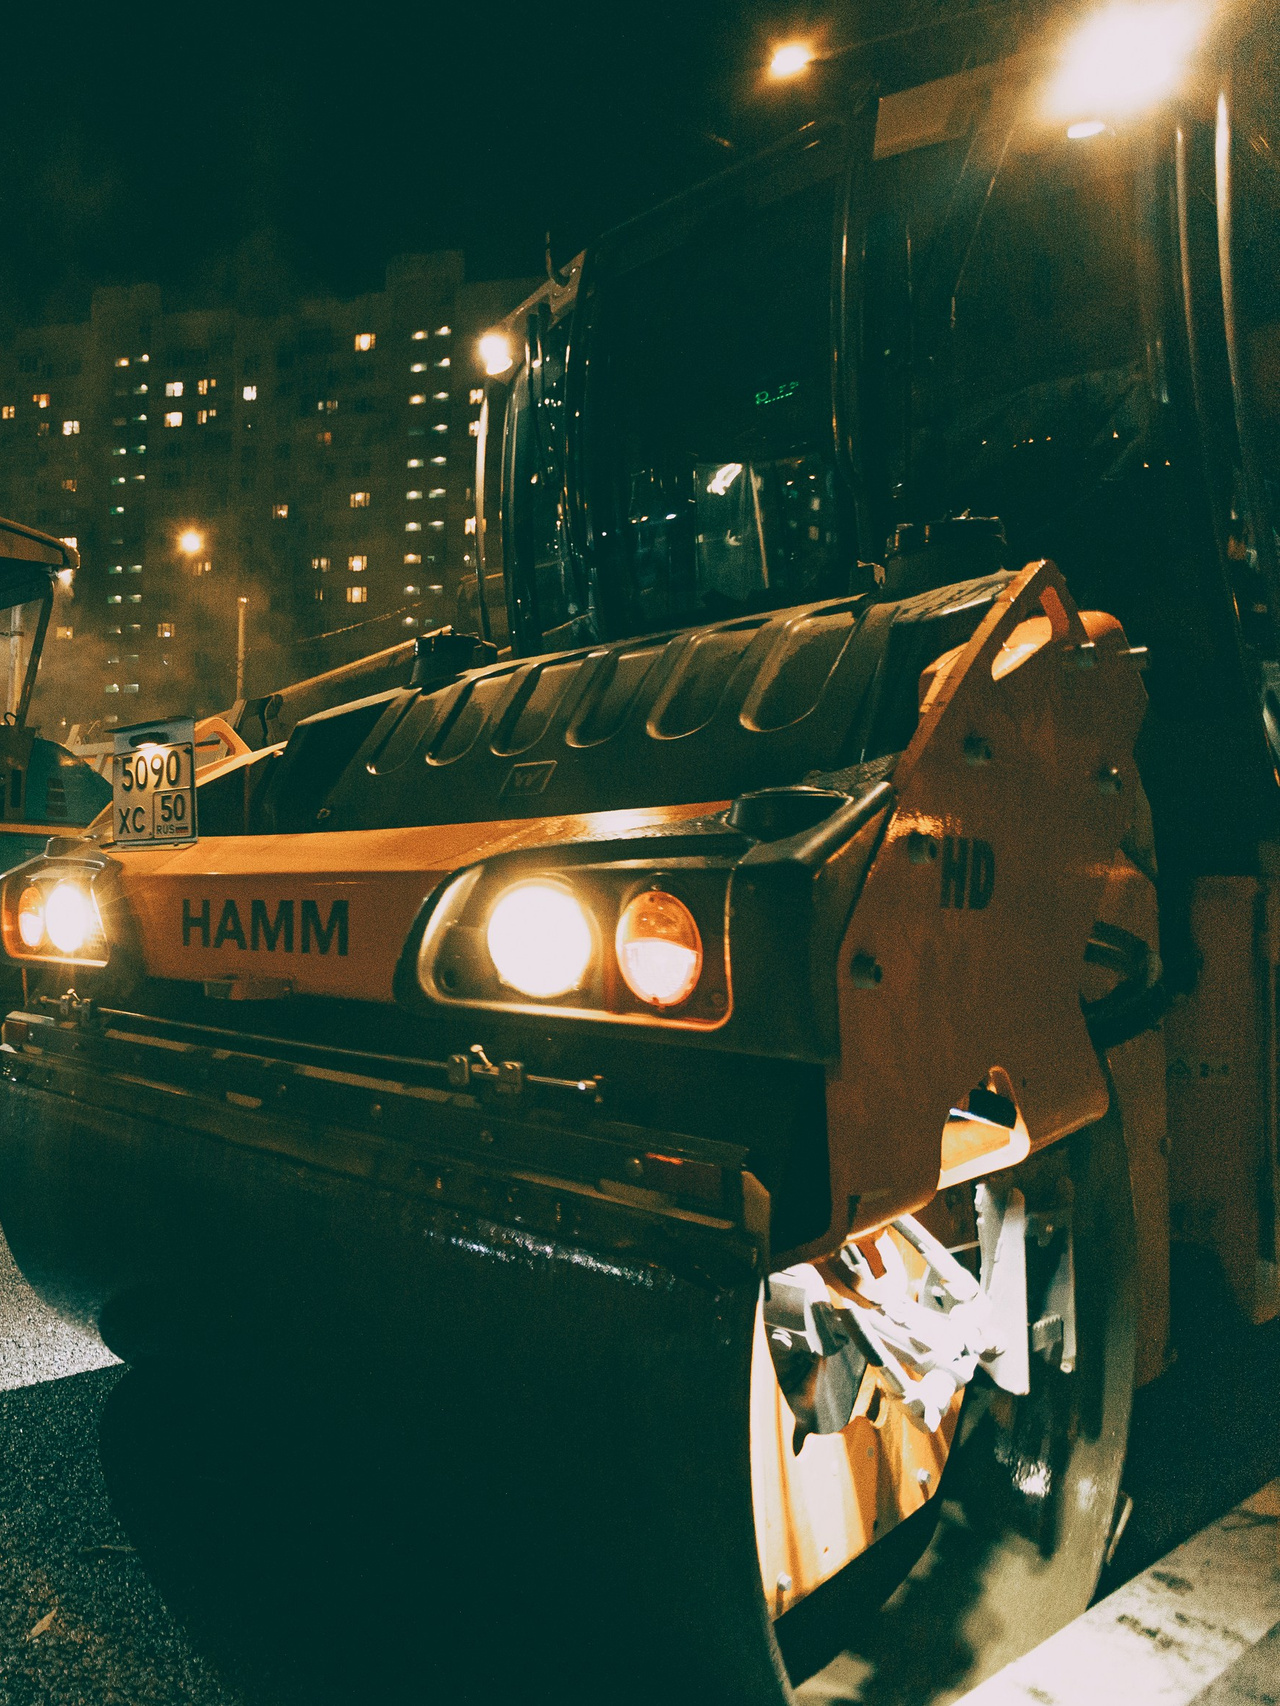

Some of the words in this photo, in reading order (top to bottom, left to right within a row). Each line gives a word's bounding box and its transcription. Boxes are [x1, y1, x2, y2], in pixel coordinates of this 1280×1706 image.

[121, 750, 180, 792] 5090
[118, 806, 145, 834] XC
[161, 793, 185, 822] 50
[156, 824, 176, 835] RUS
[939, 834, 995, 910] HD
[182, 899, 349, 956] HAMM
